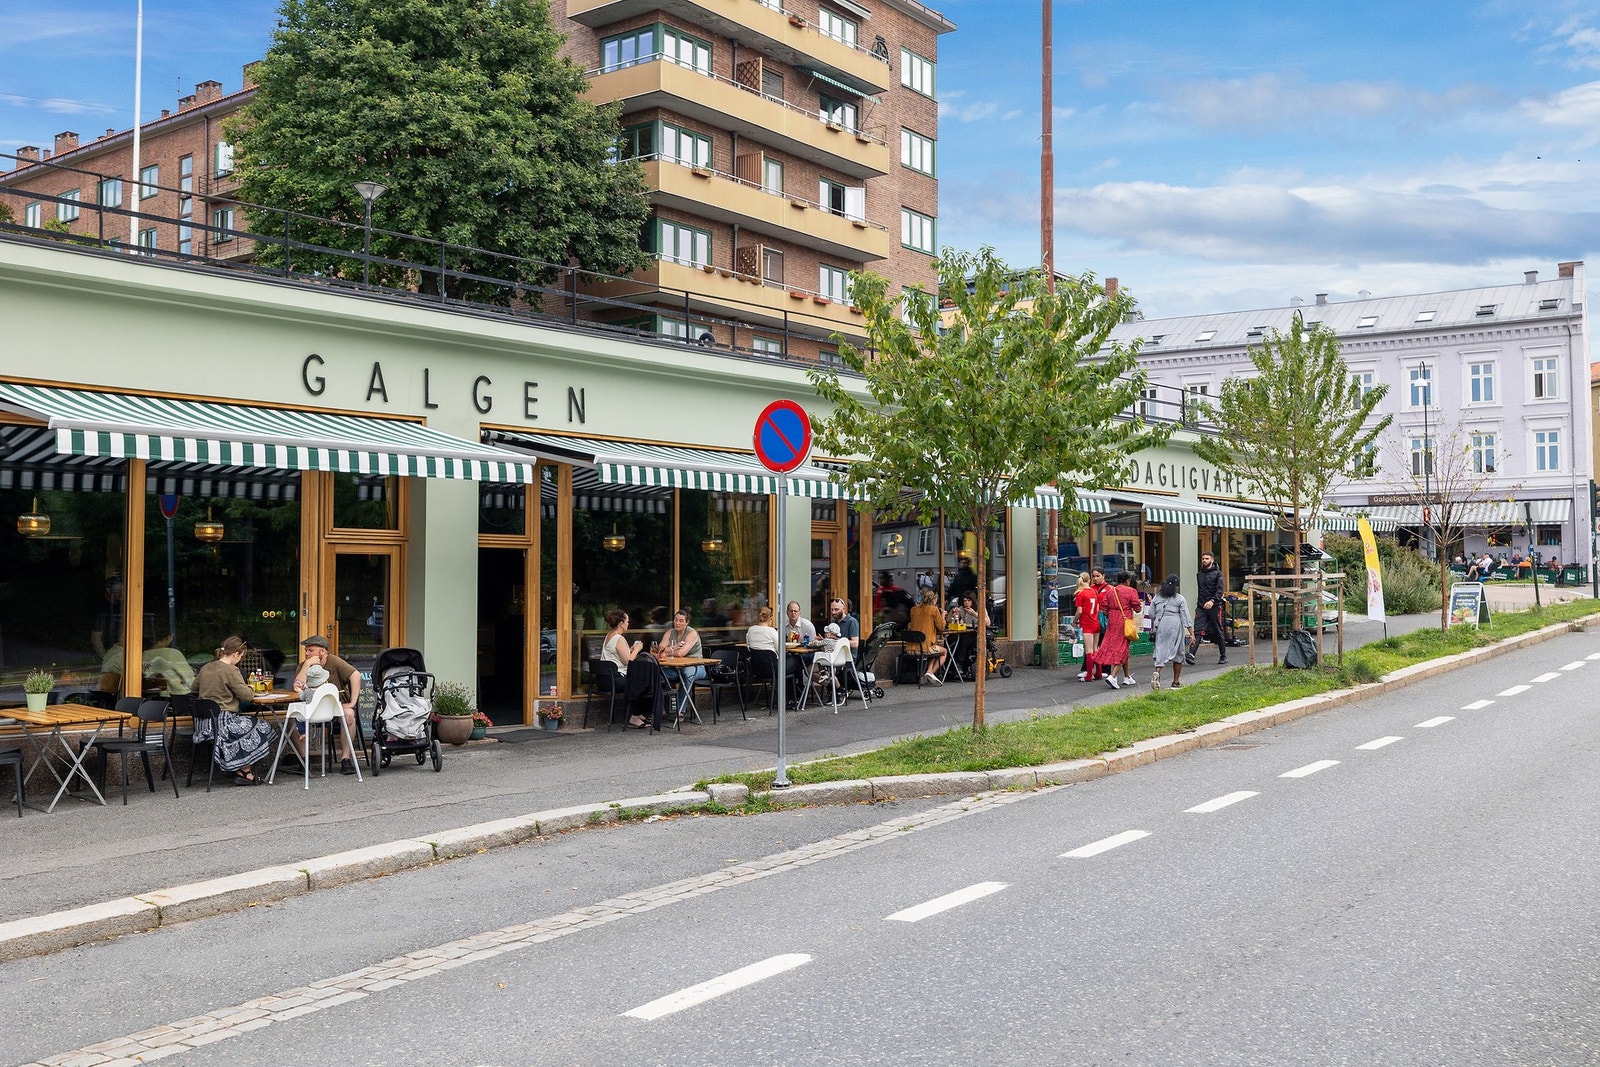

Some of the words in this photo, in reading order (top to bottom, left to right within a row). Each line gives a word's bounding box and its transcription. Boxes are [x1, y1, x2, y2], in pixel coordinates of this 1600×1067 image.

[302, 353, 586, 424] GALGEN
[1130, 459, 1243, 495] DAGLIGVARE
[1090, 598, 1096, 614] 7
